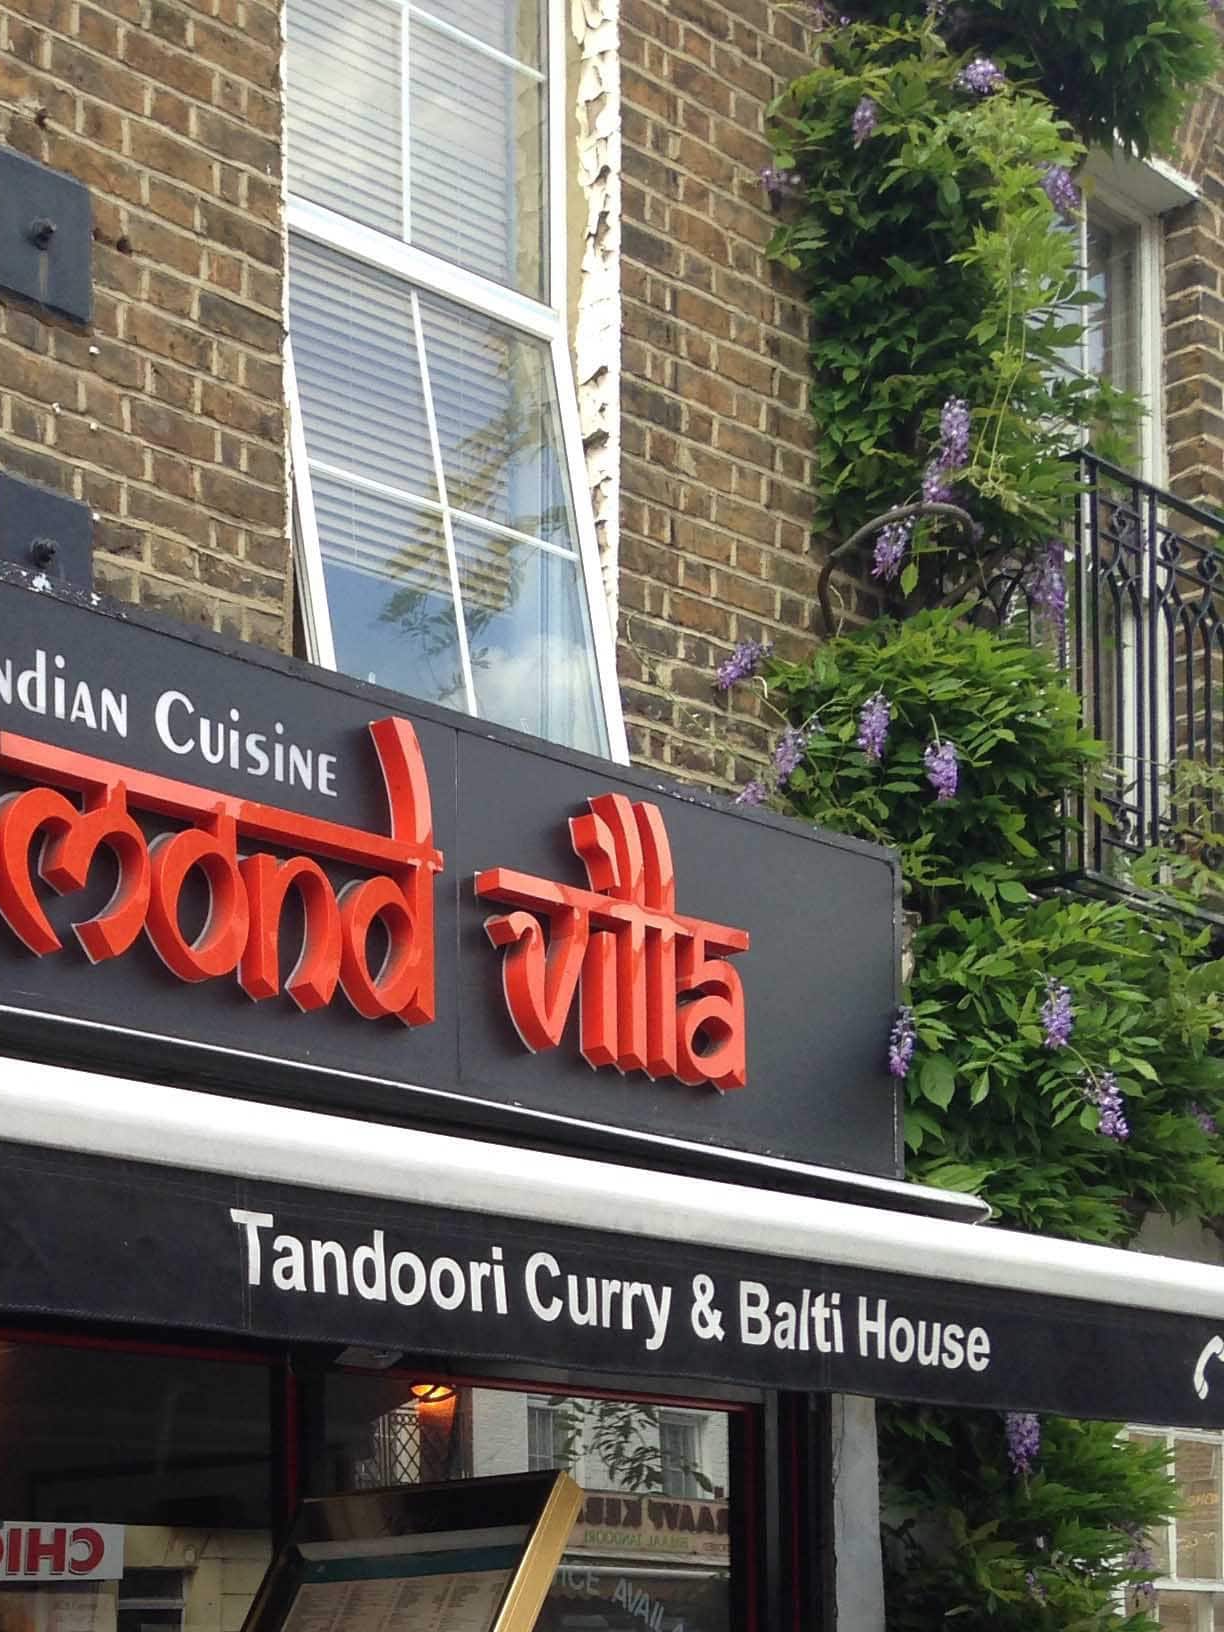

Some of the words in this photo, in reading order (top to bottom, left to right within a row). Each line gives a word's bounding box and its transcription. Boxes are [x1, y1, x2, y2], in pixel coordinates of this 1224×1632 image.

[474, 793, 750, 1095] villa
[229, 1209, 507, 1315] Tandoori
[525, 1251, 673, 1351] Curry
[690, 1273, 725, 1343] &
[739, 1281, 845, 1355] Balti
[858, 1296, 992, 1372] House
